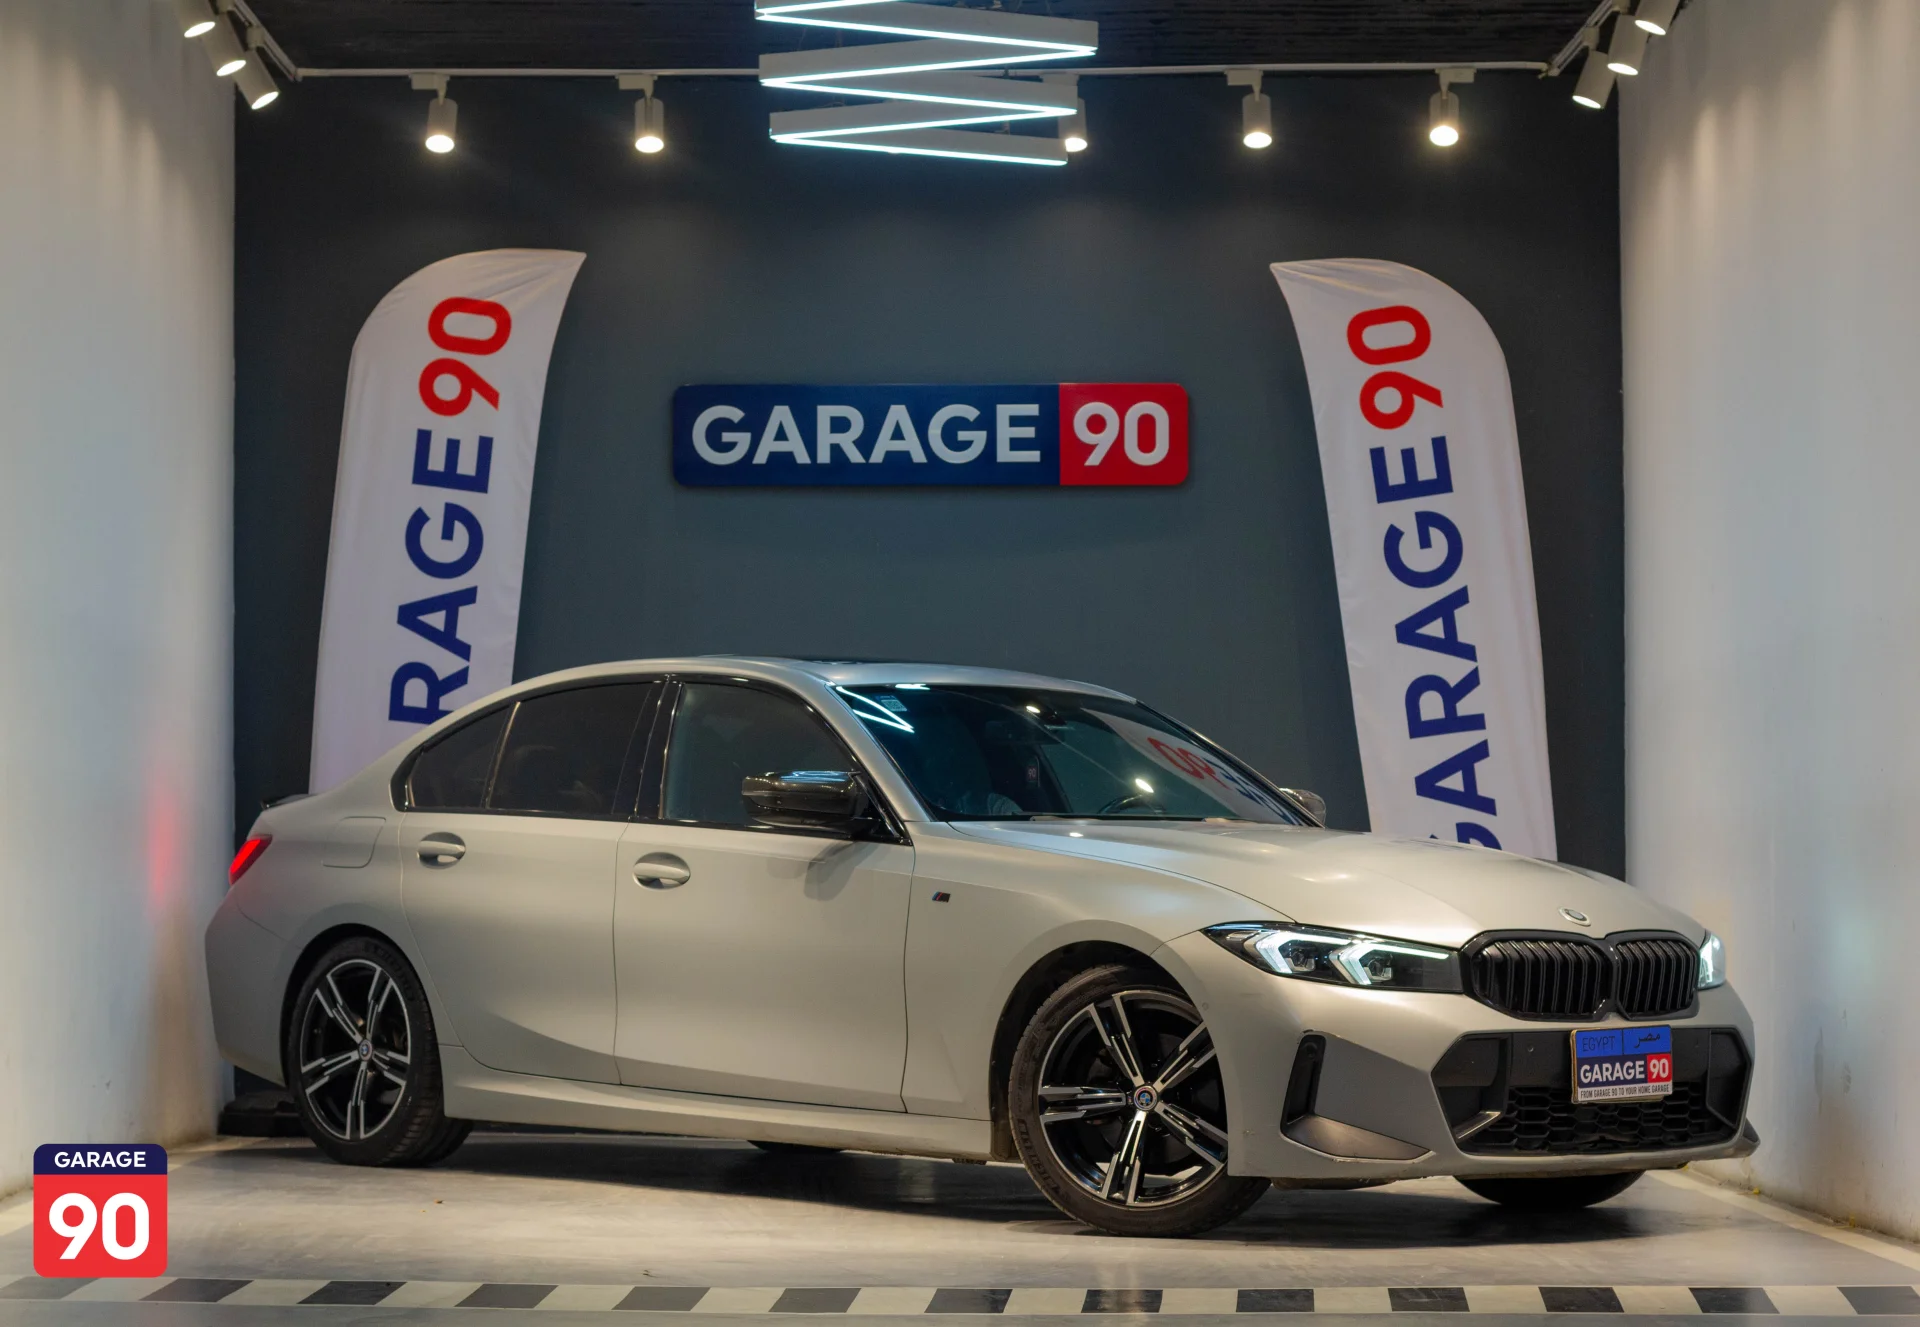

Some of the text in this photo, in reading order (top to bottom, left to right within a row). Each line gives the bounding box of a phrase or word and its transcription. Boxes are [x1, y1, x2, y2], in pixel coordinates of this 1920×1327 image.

[692, 401, 1170, 466] GARAGE 90
[1582, 1035, 1616, 1052] EGYPT
[1633, 1032, 1661, 1049] مصر
[1580, 1058, 1669, 1084] GARAGE 90
[1580, 1084, 1669, 1099] FROM GARAGE 90 TO YOUR HOME GARAGE
